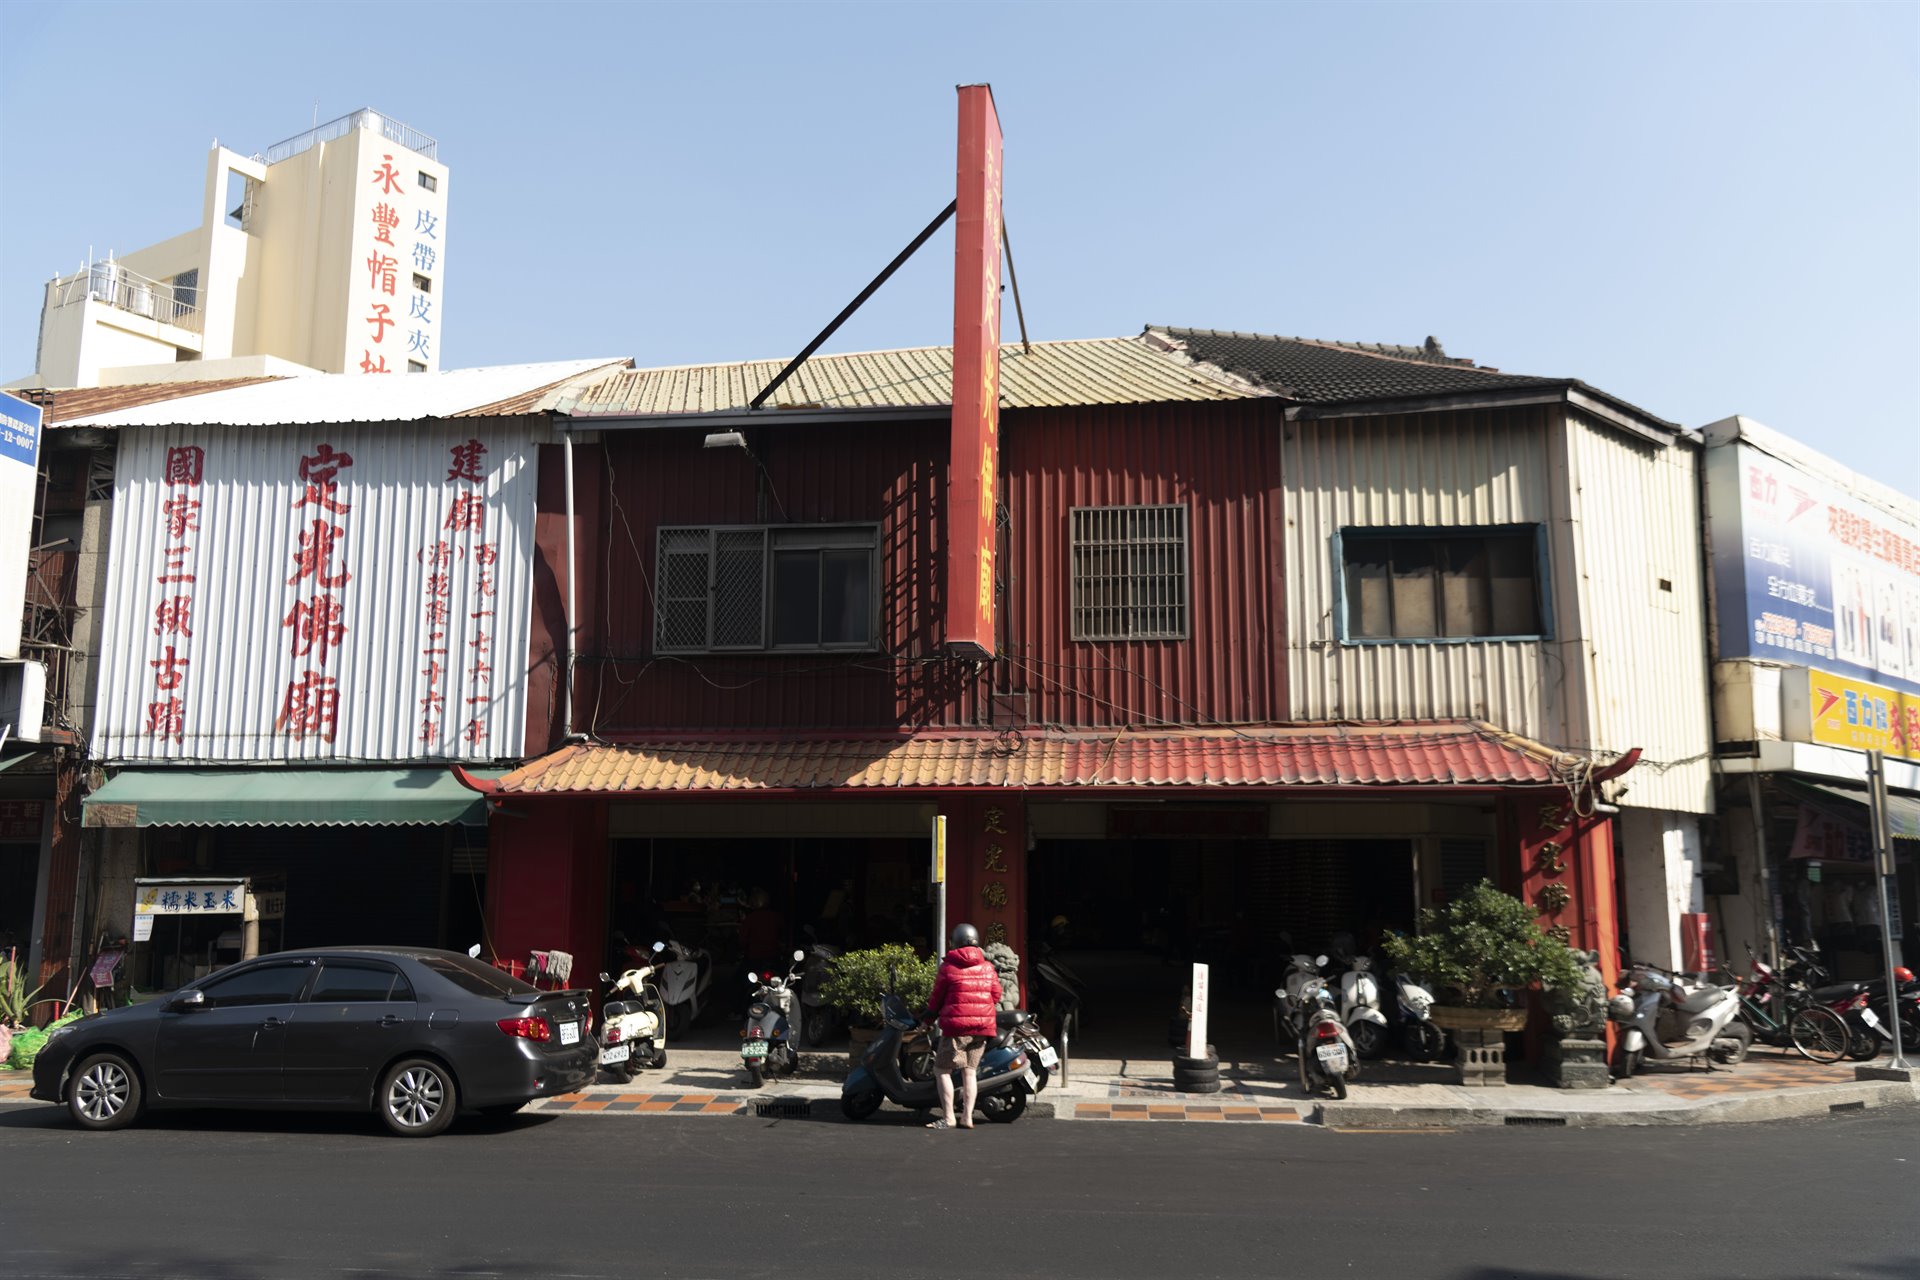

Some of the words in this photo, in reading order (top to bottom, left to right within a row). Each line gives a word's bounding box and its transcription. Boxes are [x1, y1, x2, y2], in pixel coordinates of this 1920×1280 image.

[412, 209, 438, 272] 皮帶
[408, 293, 432, 360] 皮夾
[444, 438, 488, 535] 建廟
[979, 255, 996, 625] 定光佛廟
[144, 446, 205, 745] 國家三級古蹟
[275, 443, 354, 744] 定光佛廟
[464, 543, 497, 746] 西元一七六一年
[162, 889, 238, 912] 糯米玉米
